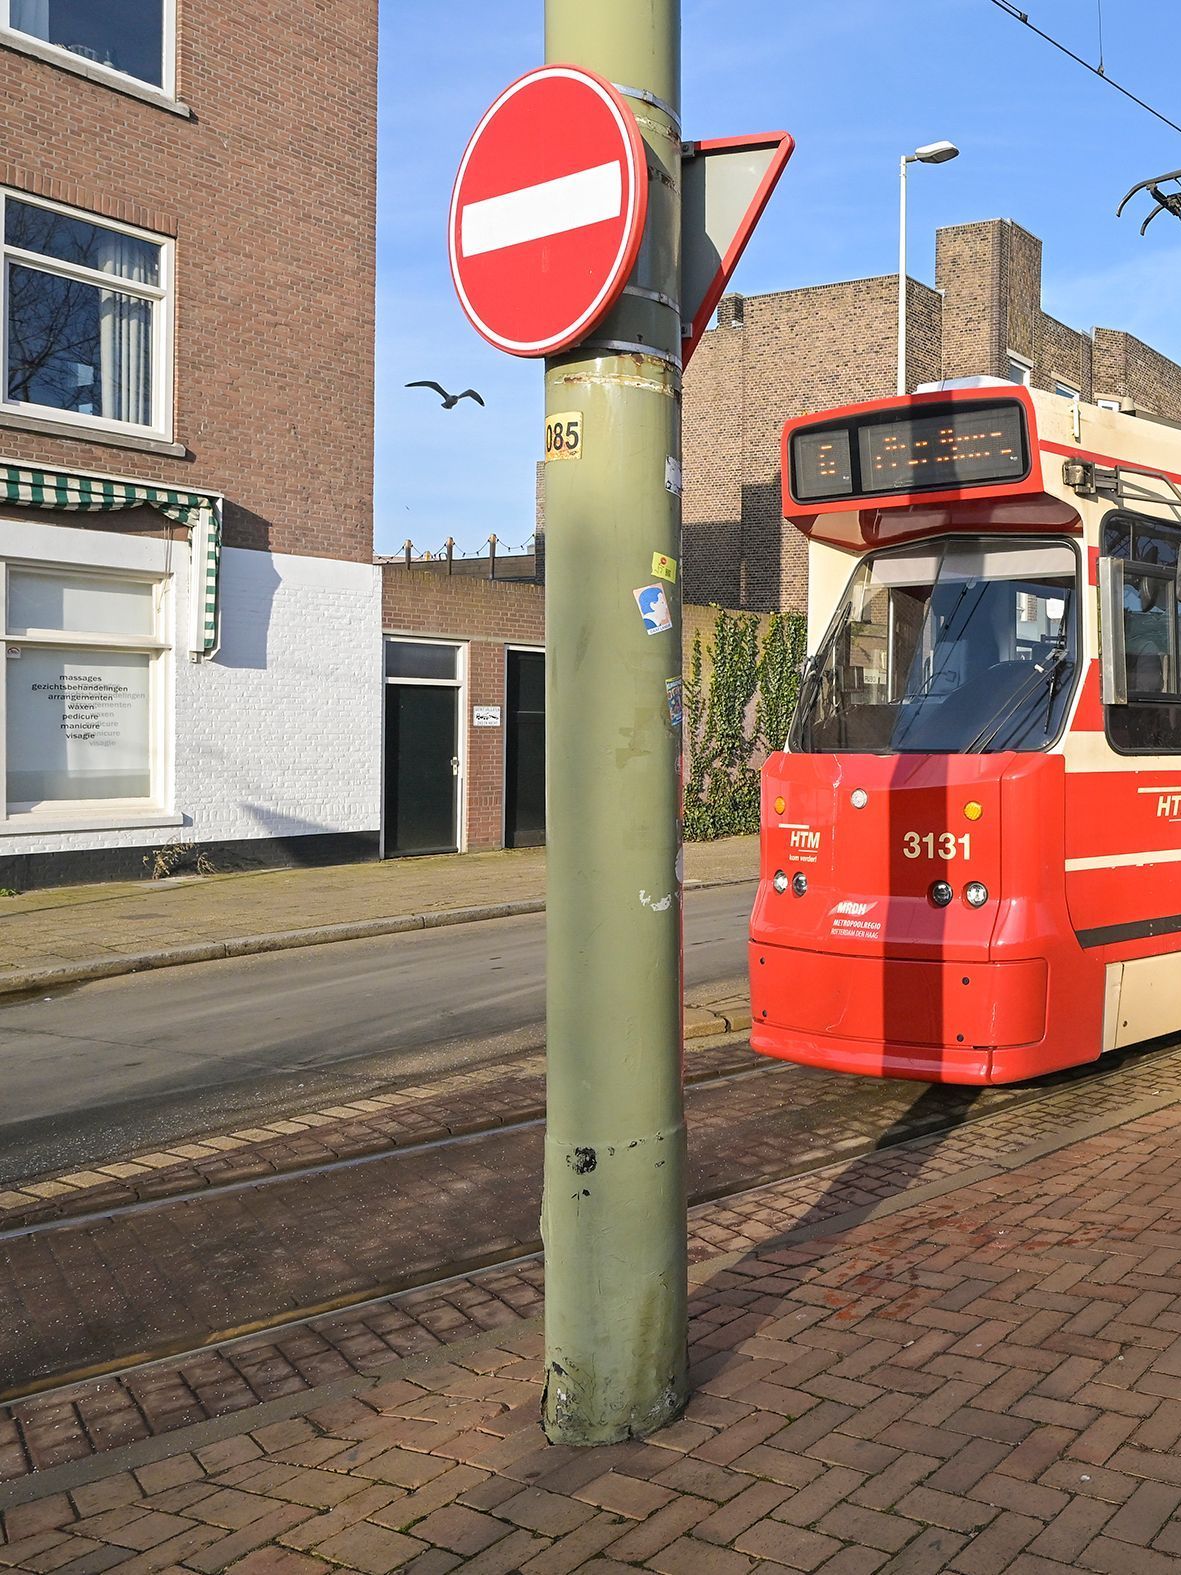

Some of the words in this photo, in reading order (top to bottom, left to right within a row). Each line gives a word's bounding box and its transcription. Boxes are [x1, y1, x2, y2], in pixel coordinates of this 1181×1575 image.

[31, 683, 128, 693] gezichtsbehandelingen
[48, 693, 113, 701] arrangementen
[65, 732, 96, 740] visagie
[790, 831, 821, 849] HTM
[903, 831, 971, 860] 3131
[836, 901, 867, 915] MRDH
